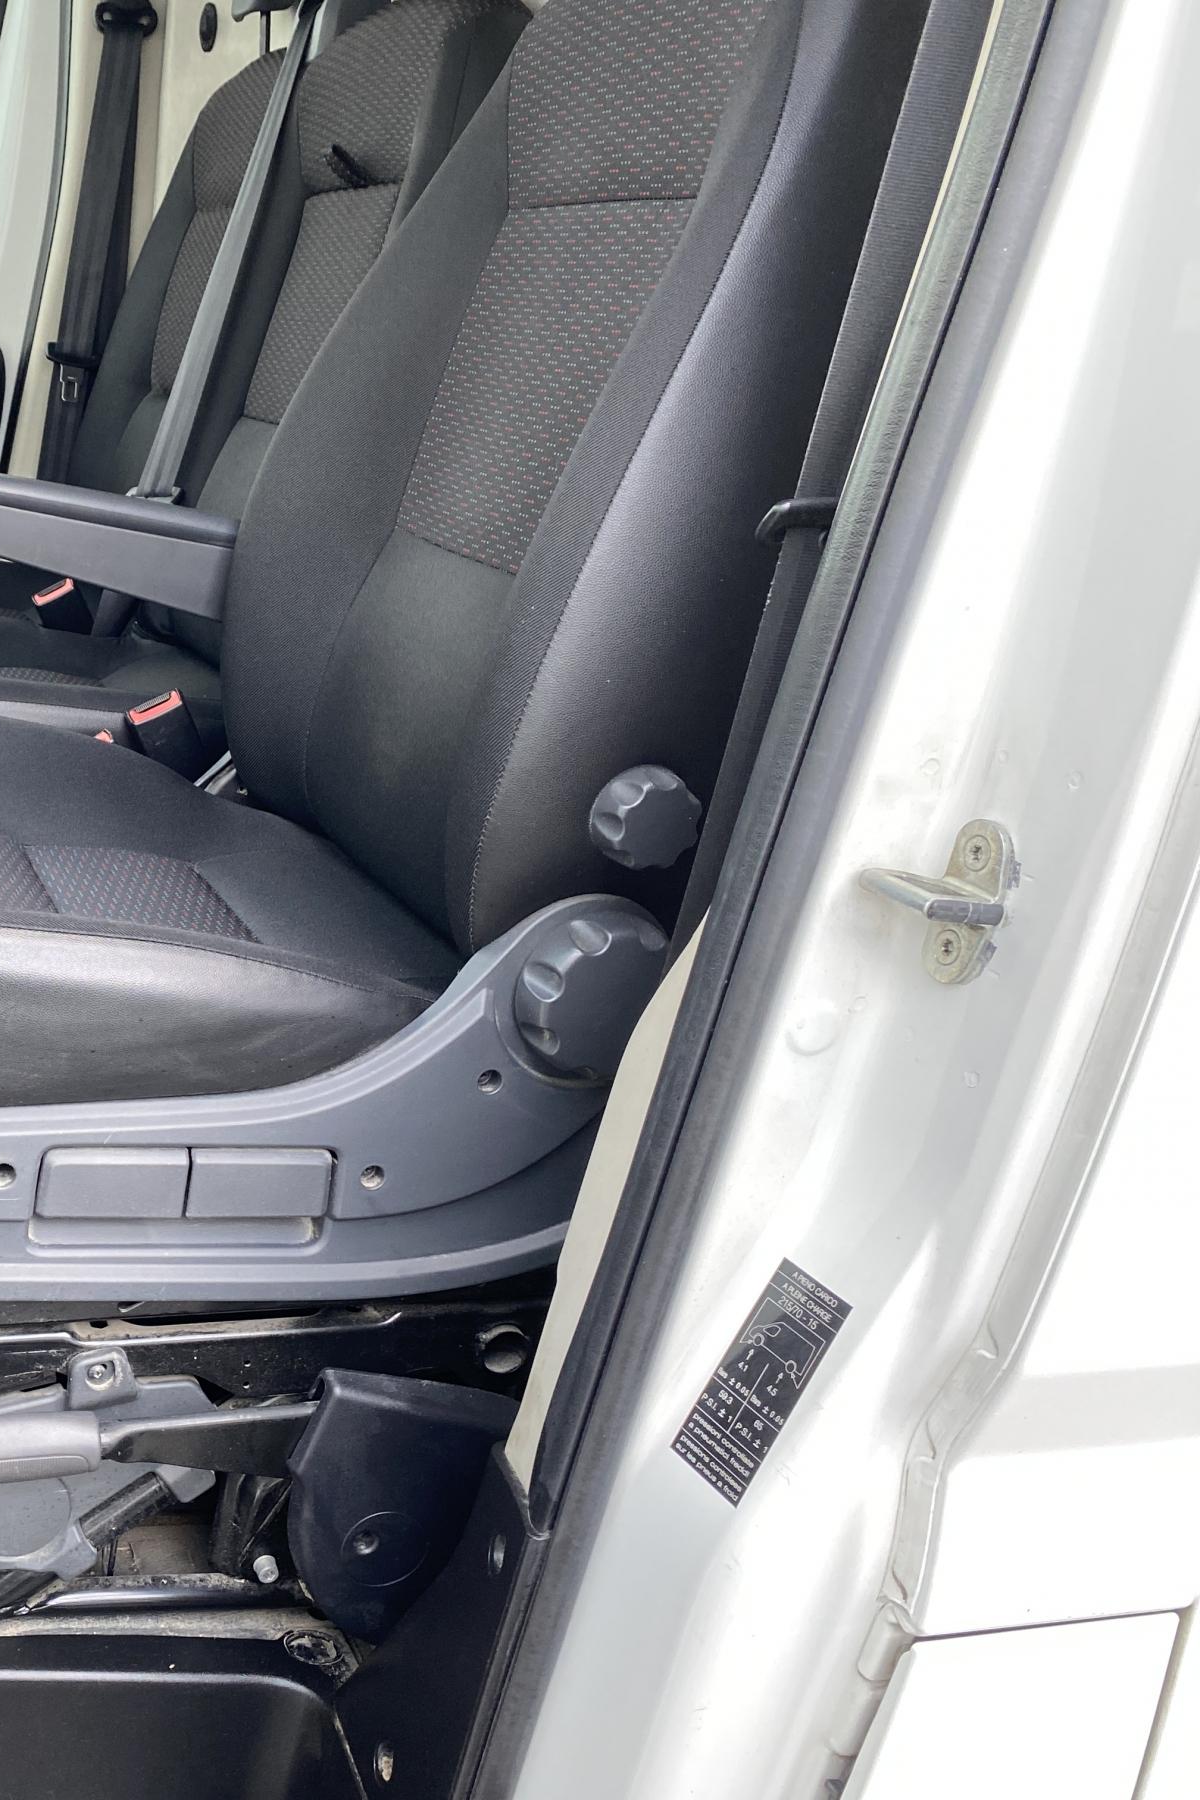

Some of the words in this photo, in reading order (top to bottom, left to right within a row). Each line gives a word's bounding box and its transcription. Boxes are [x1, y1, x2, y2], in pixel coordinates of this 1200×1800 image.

[787, 1285, 808, 1304] PLEINE
[806, 1300, 833, 1322] CHARGE
[798, 1274, 815, 1291] PIENO
[815, 1288, 838, 1308] CARICO
[778, 1296, 803, 1318] 215/70
[807, 1318, 819, 1330] 15
[738, 1361, 749, 1372] 4.1
[766, 1385, 778, 1397] 4.5
[693, 1413, 722, 1439] pressioni
[721, 1438, 754, 1469] controllate
[753, 1420, 764, 1431] 65
[680, 1435, 710, 1463] pressions
[694, 1427, 730, 1460] pneumatici
[729, 1457, 750, 1478] freddi
[675, 1442, 687, 1453] sur
[686, 1451, 697, 1463] les
[695, 1462, 717, 1482] pneus
[723, 1485, 738, 1501] froid
